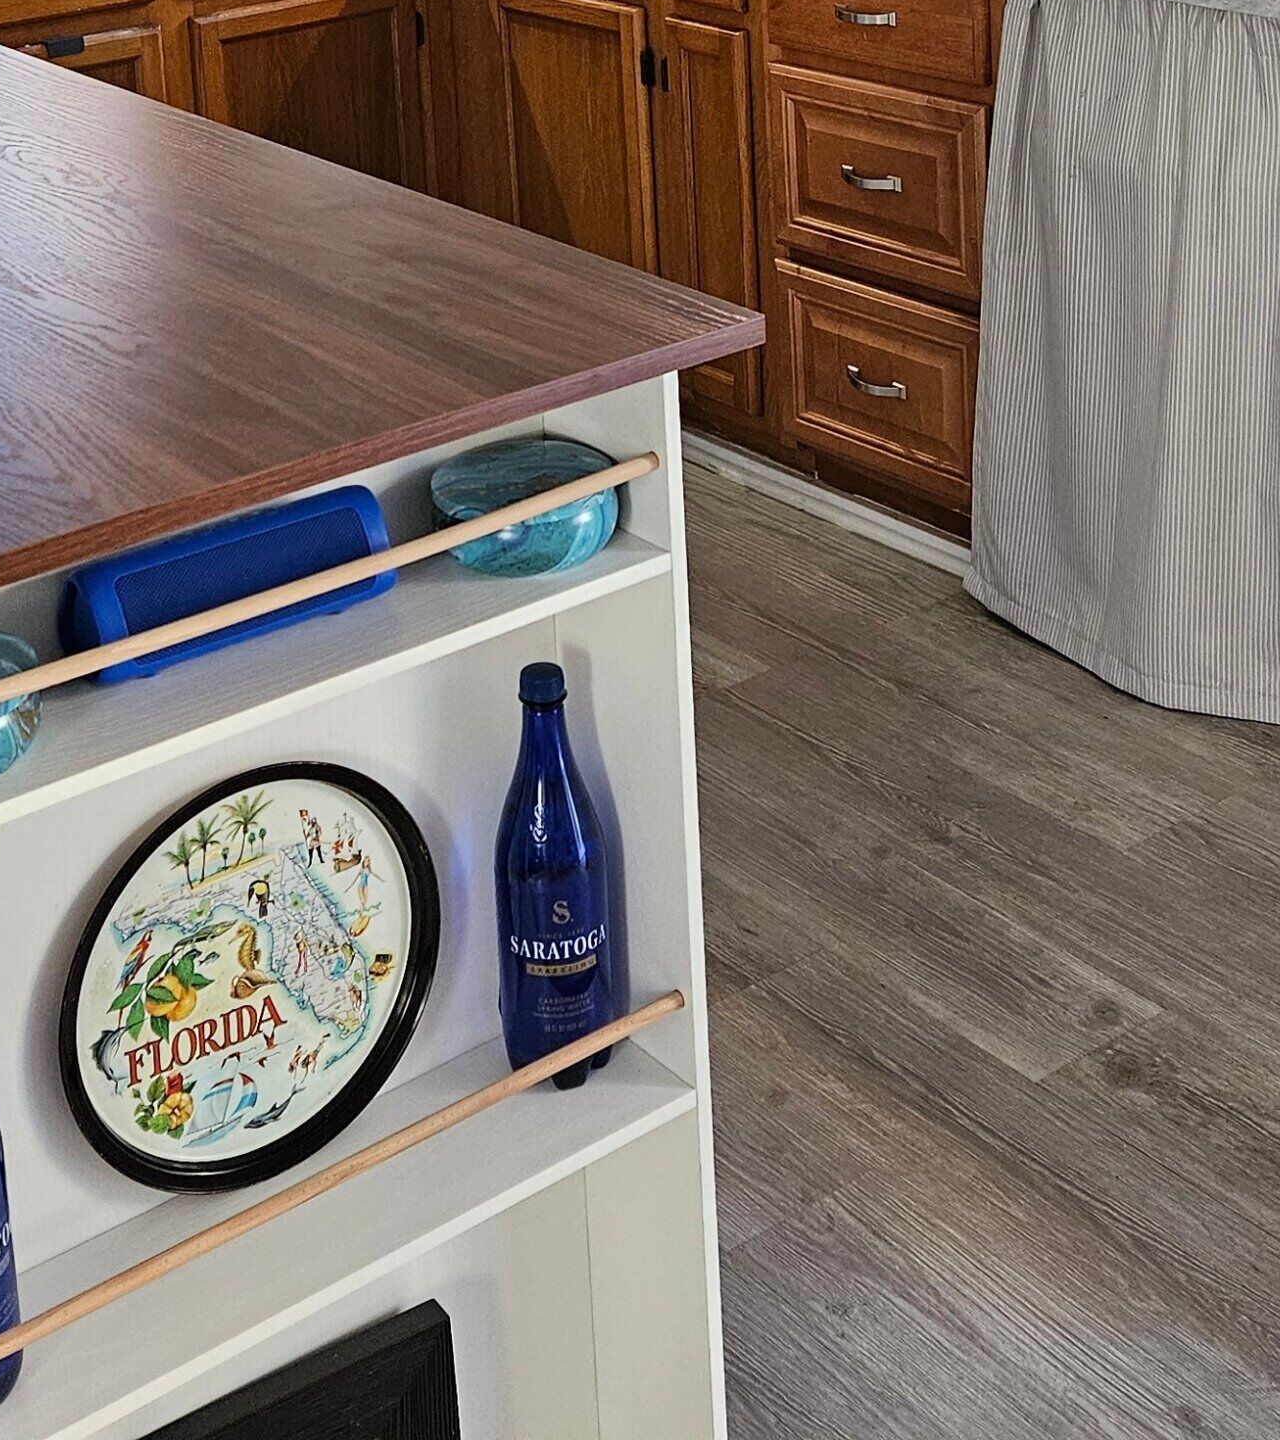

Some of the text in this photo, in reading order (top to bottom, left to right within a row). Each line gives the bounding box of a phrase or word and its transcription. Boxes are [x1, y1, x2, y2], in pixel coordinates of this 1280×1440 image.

[552, 900, 570, 924] S
[510, 923, 606, 960] SARATOGA
[124, 994, 288, 1088] FLORIDA
